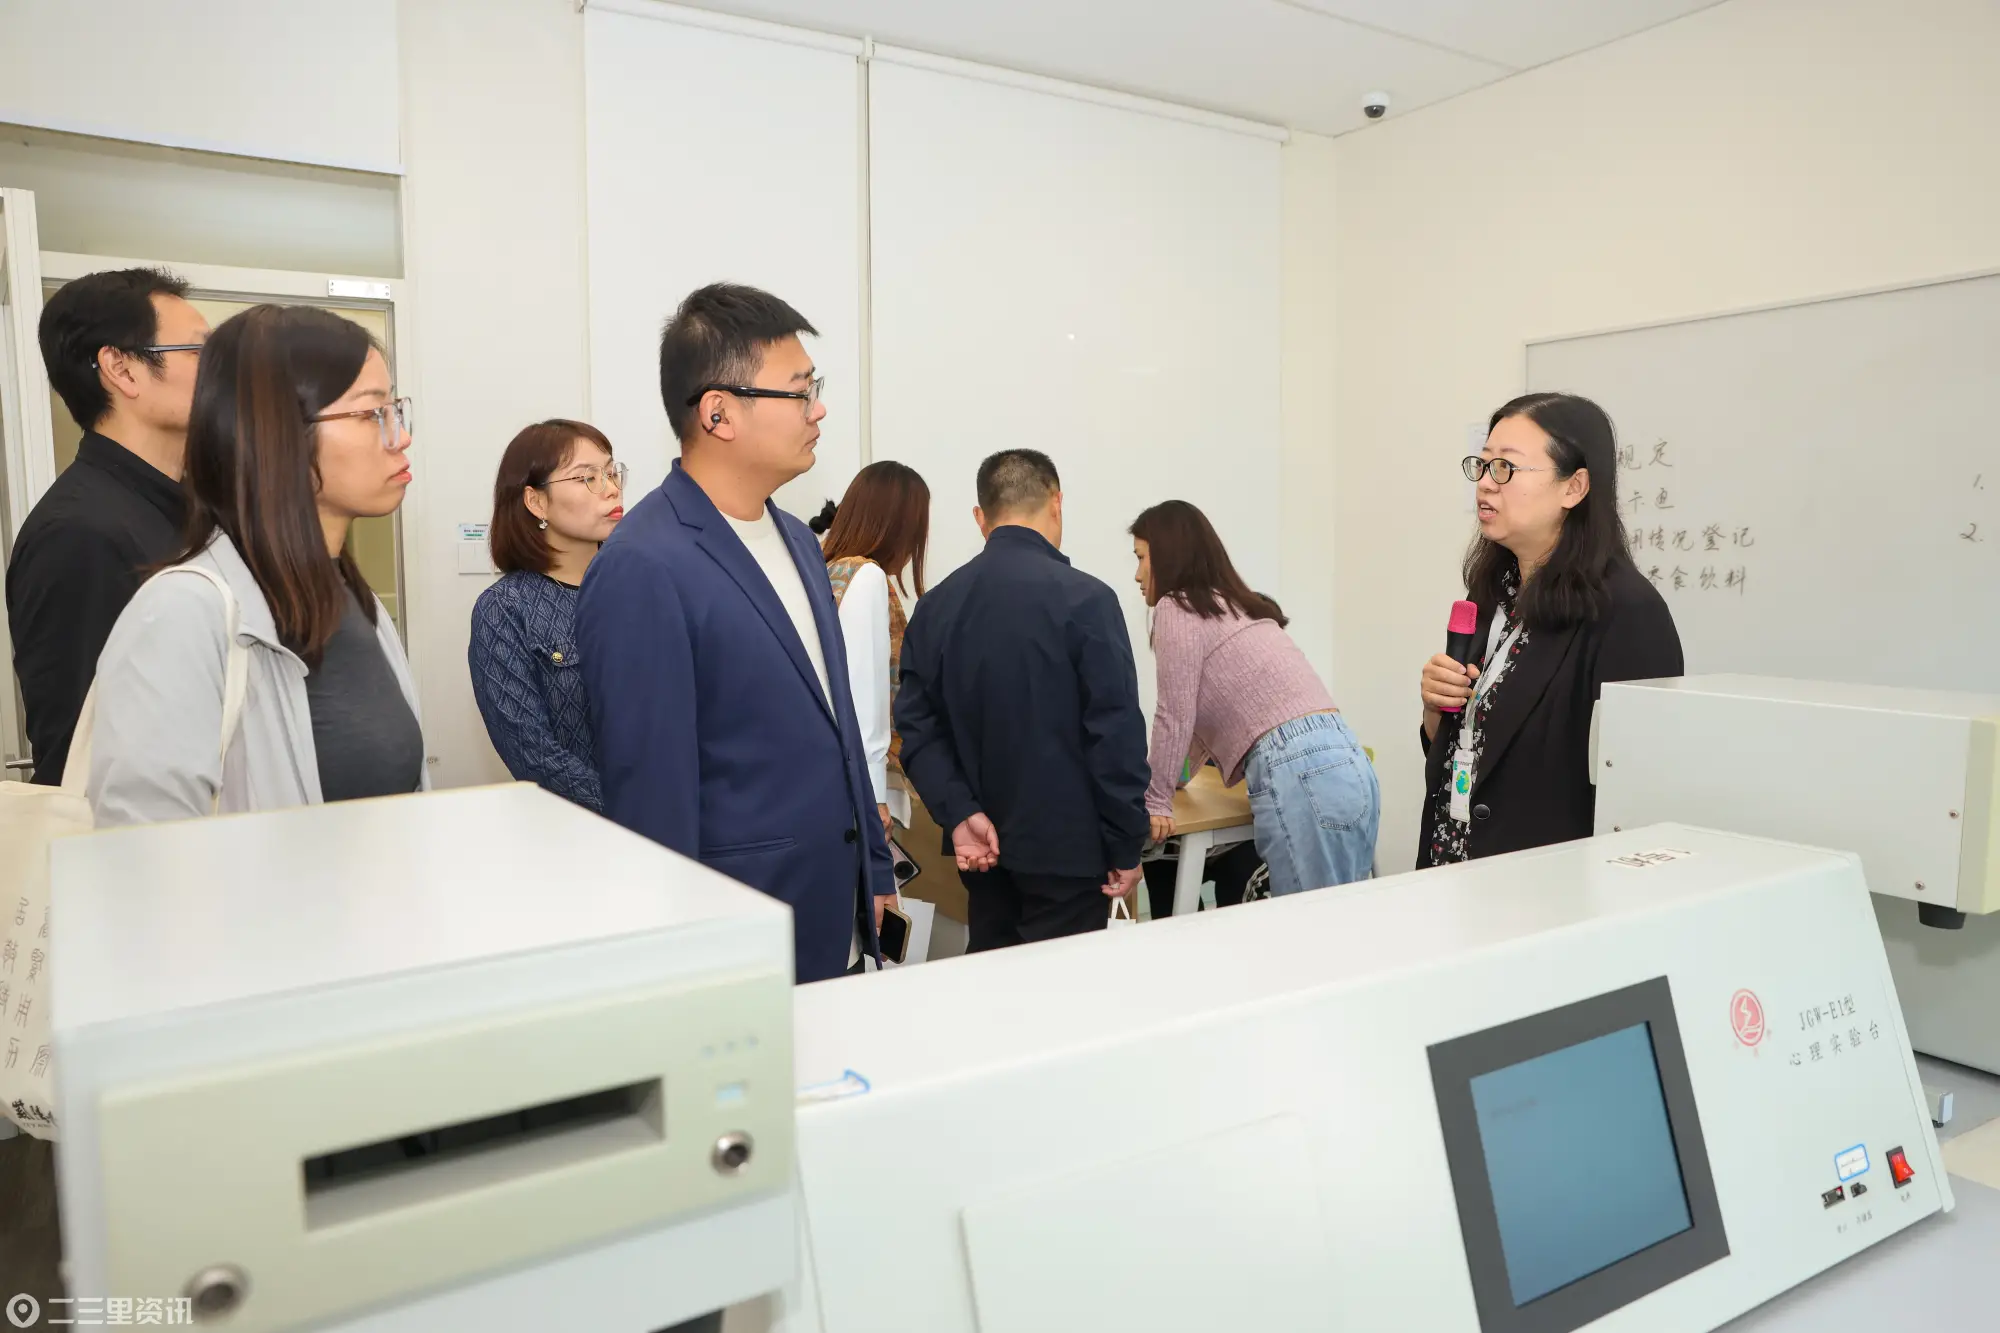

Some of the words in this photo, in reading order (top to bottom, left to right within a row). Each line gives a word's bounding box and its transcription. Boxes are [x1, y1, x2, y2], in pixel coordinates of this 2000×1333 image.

[1789, 1019, 1879, 1065] 心理实验台
